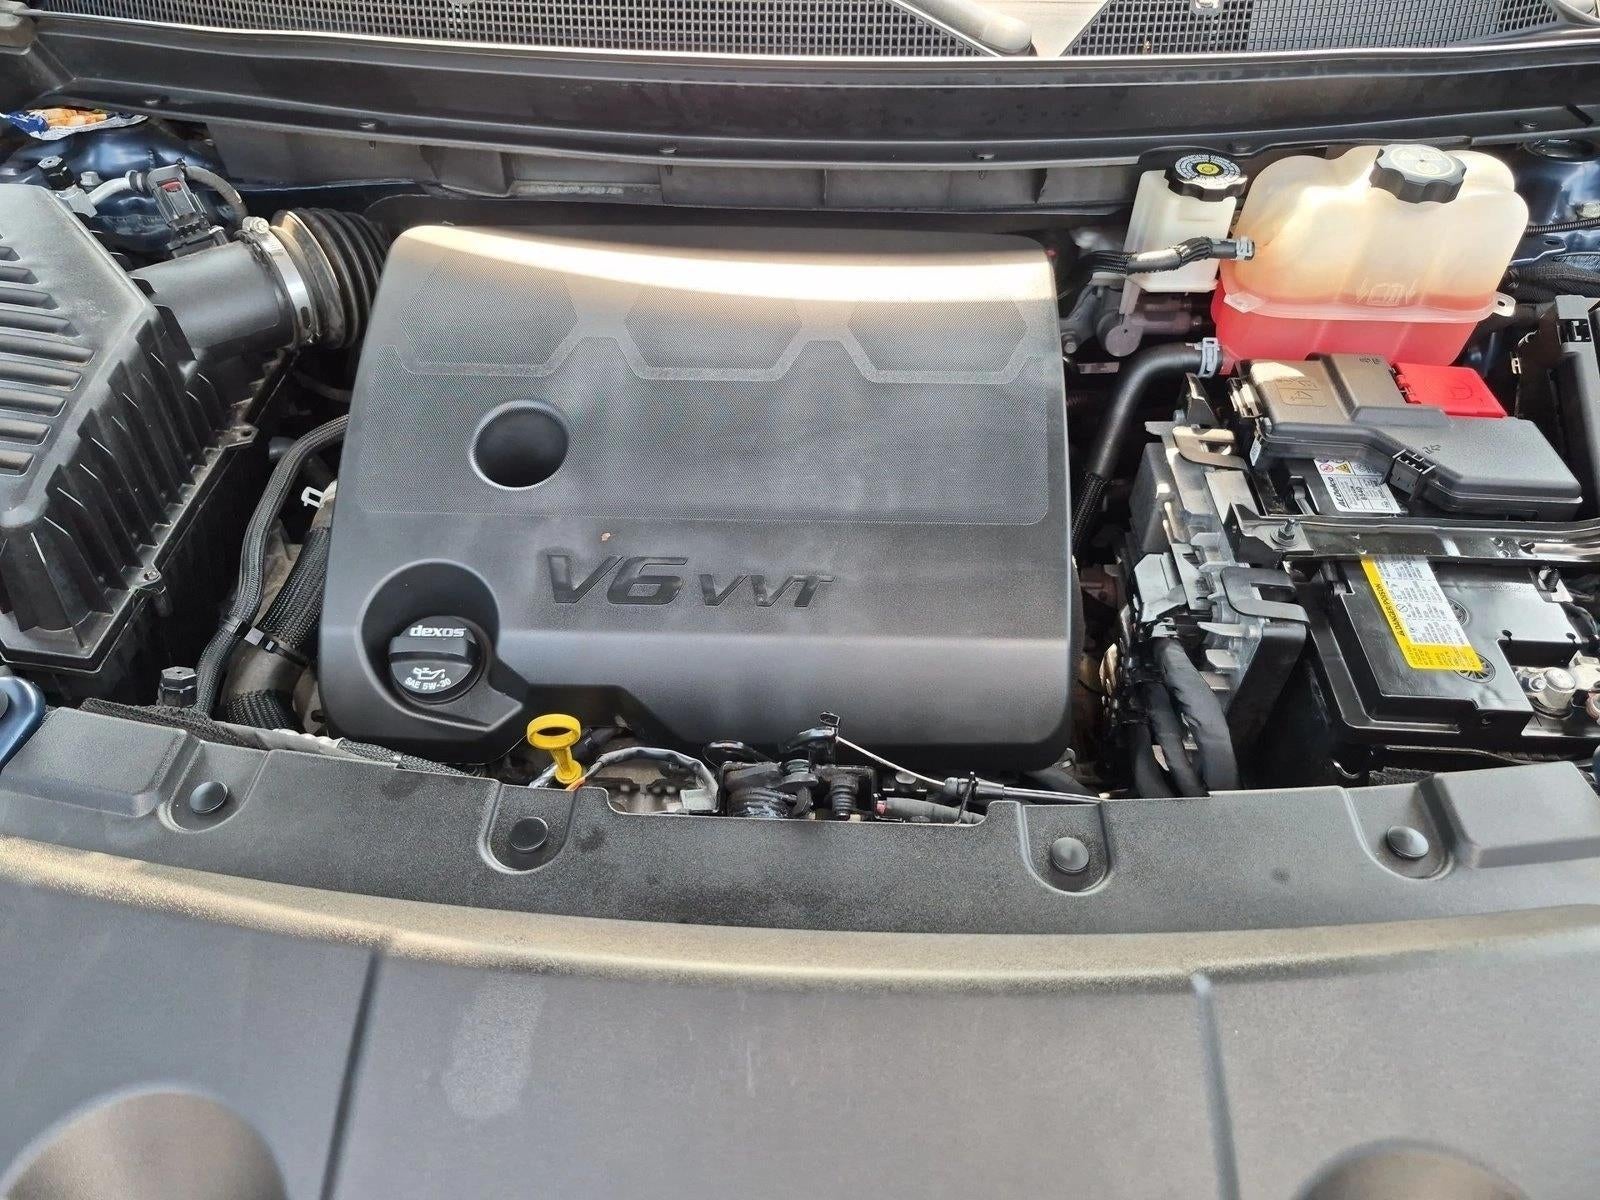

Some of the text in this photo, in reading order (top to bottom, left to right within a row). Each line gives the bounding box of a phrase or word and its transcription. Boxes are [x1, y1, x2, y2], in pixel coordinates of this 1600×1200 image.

[547, 554, 837, 608] V6 VVT
[409, 625, 467, 637] dexos
[405, 677, 452, 691] SAE 5W-30
